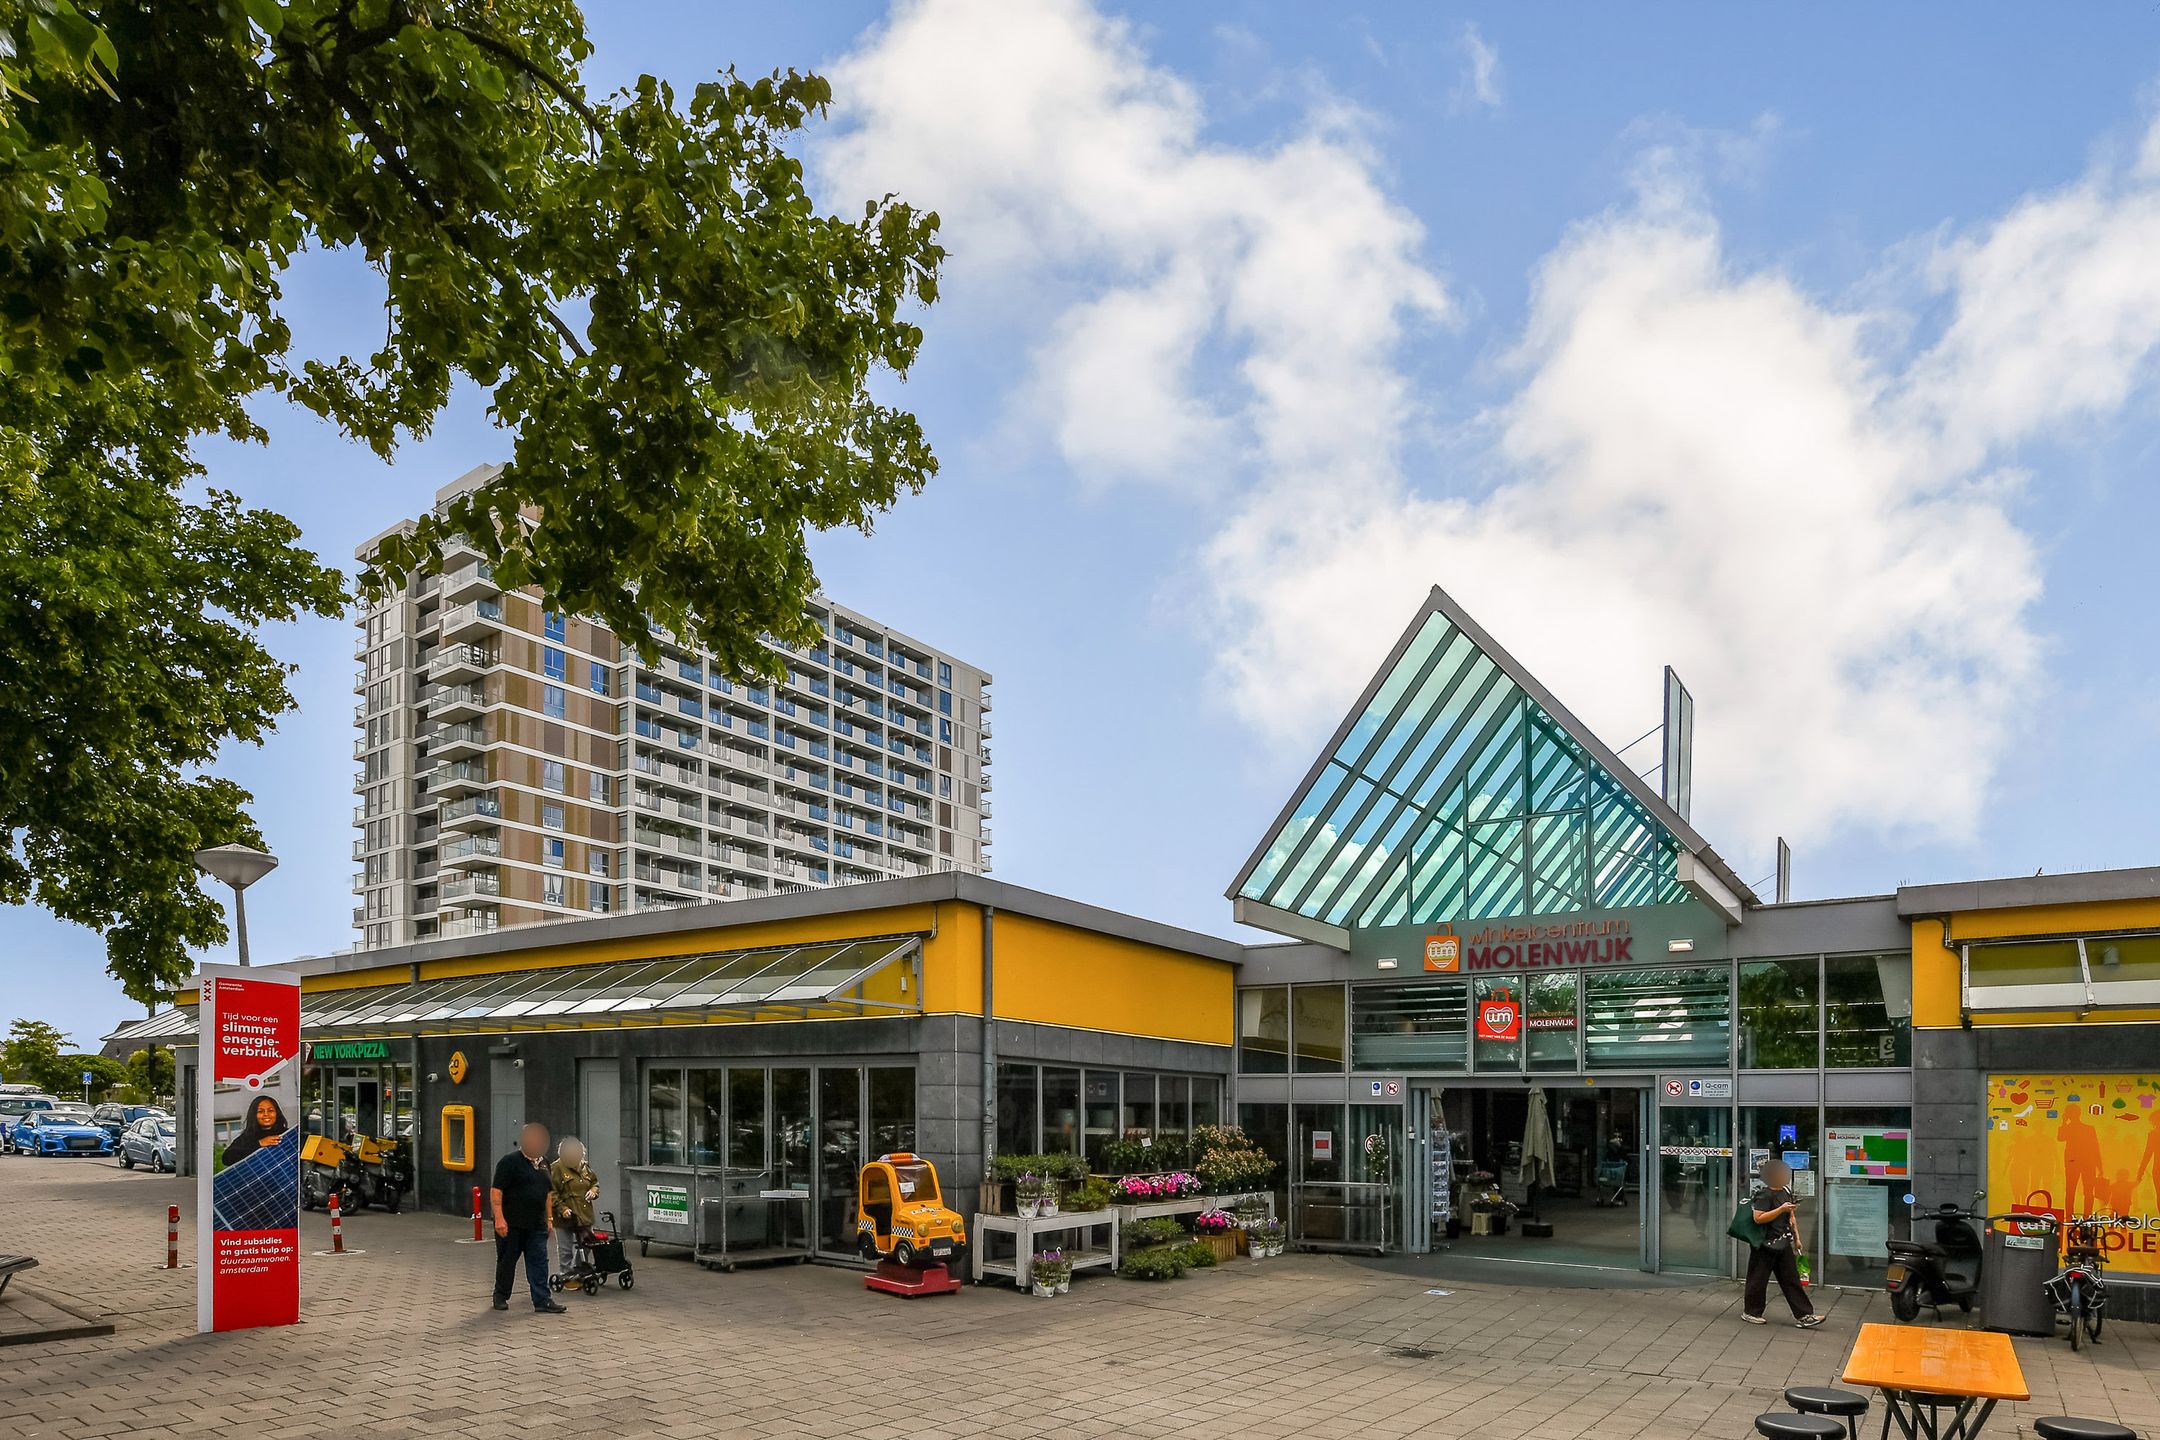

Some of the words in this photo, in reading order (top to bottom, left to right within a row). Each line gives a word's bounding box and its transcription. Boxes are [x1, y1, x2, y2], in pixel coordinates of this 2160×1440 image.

[1468, 919, 1630, 945] winkelcentrum
[1467, 937, 1633, 970] MOLENWIJK
[222, 1012, 239, 1021] Tijd
[241, 1014, 260, 1022] voor
[1529, 1018, 1574, 1028] MOLENWIJK
[222, 1021, 277, 1035] slimmer
[222, 1034, 280, 1048] energie-
[222, 1045, 283, 1058] verbruik.
[313, 1044, 334, 1059] NEW
[220, 1238, 242, 1246] Vind
[243, 1237, 283, 1245] subsidies
[234, 1247, 259, 1256] gratis
[261, 1246, 279, 1254] hulp
[281, 1246, 294, 1254] op:
[220, 1266, 269, 1275] amsterdam
